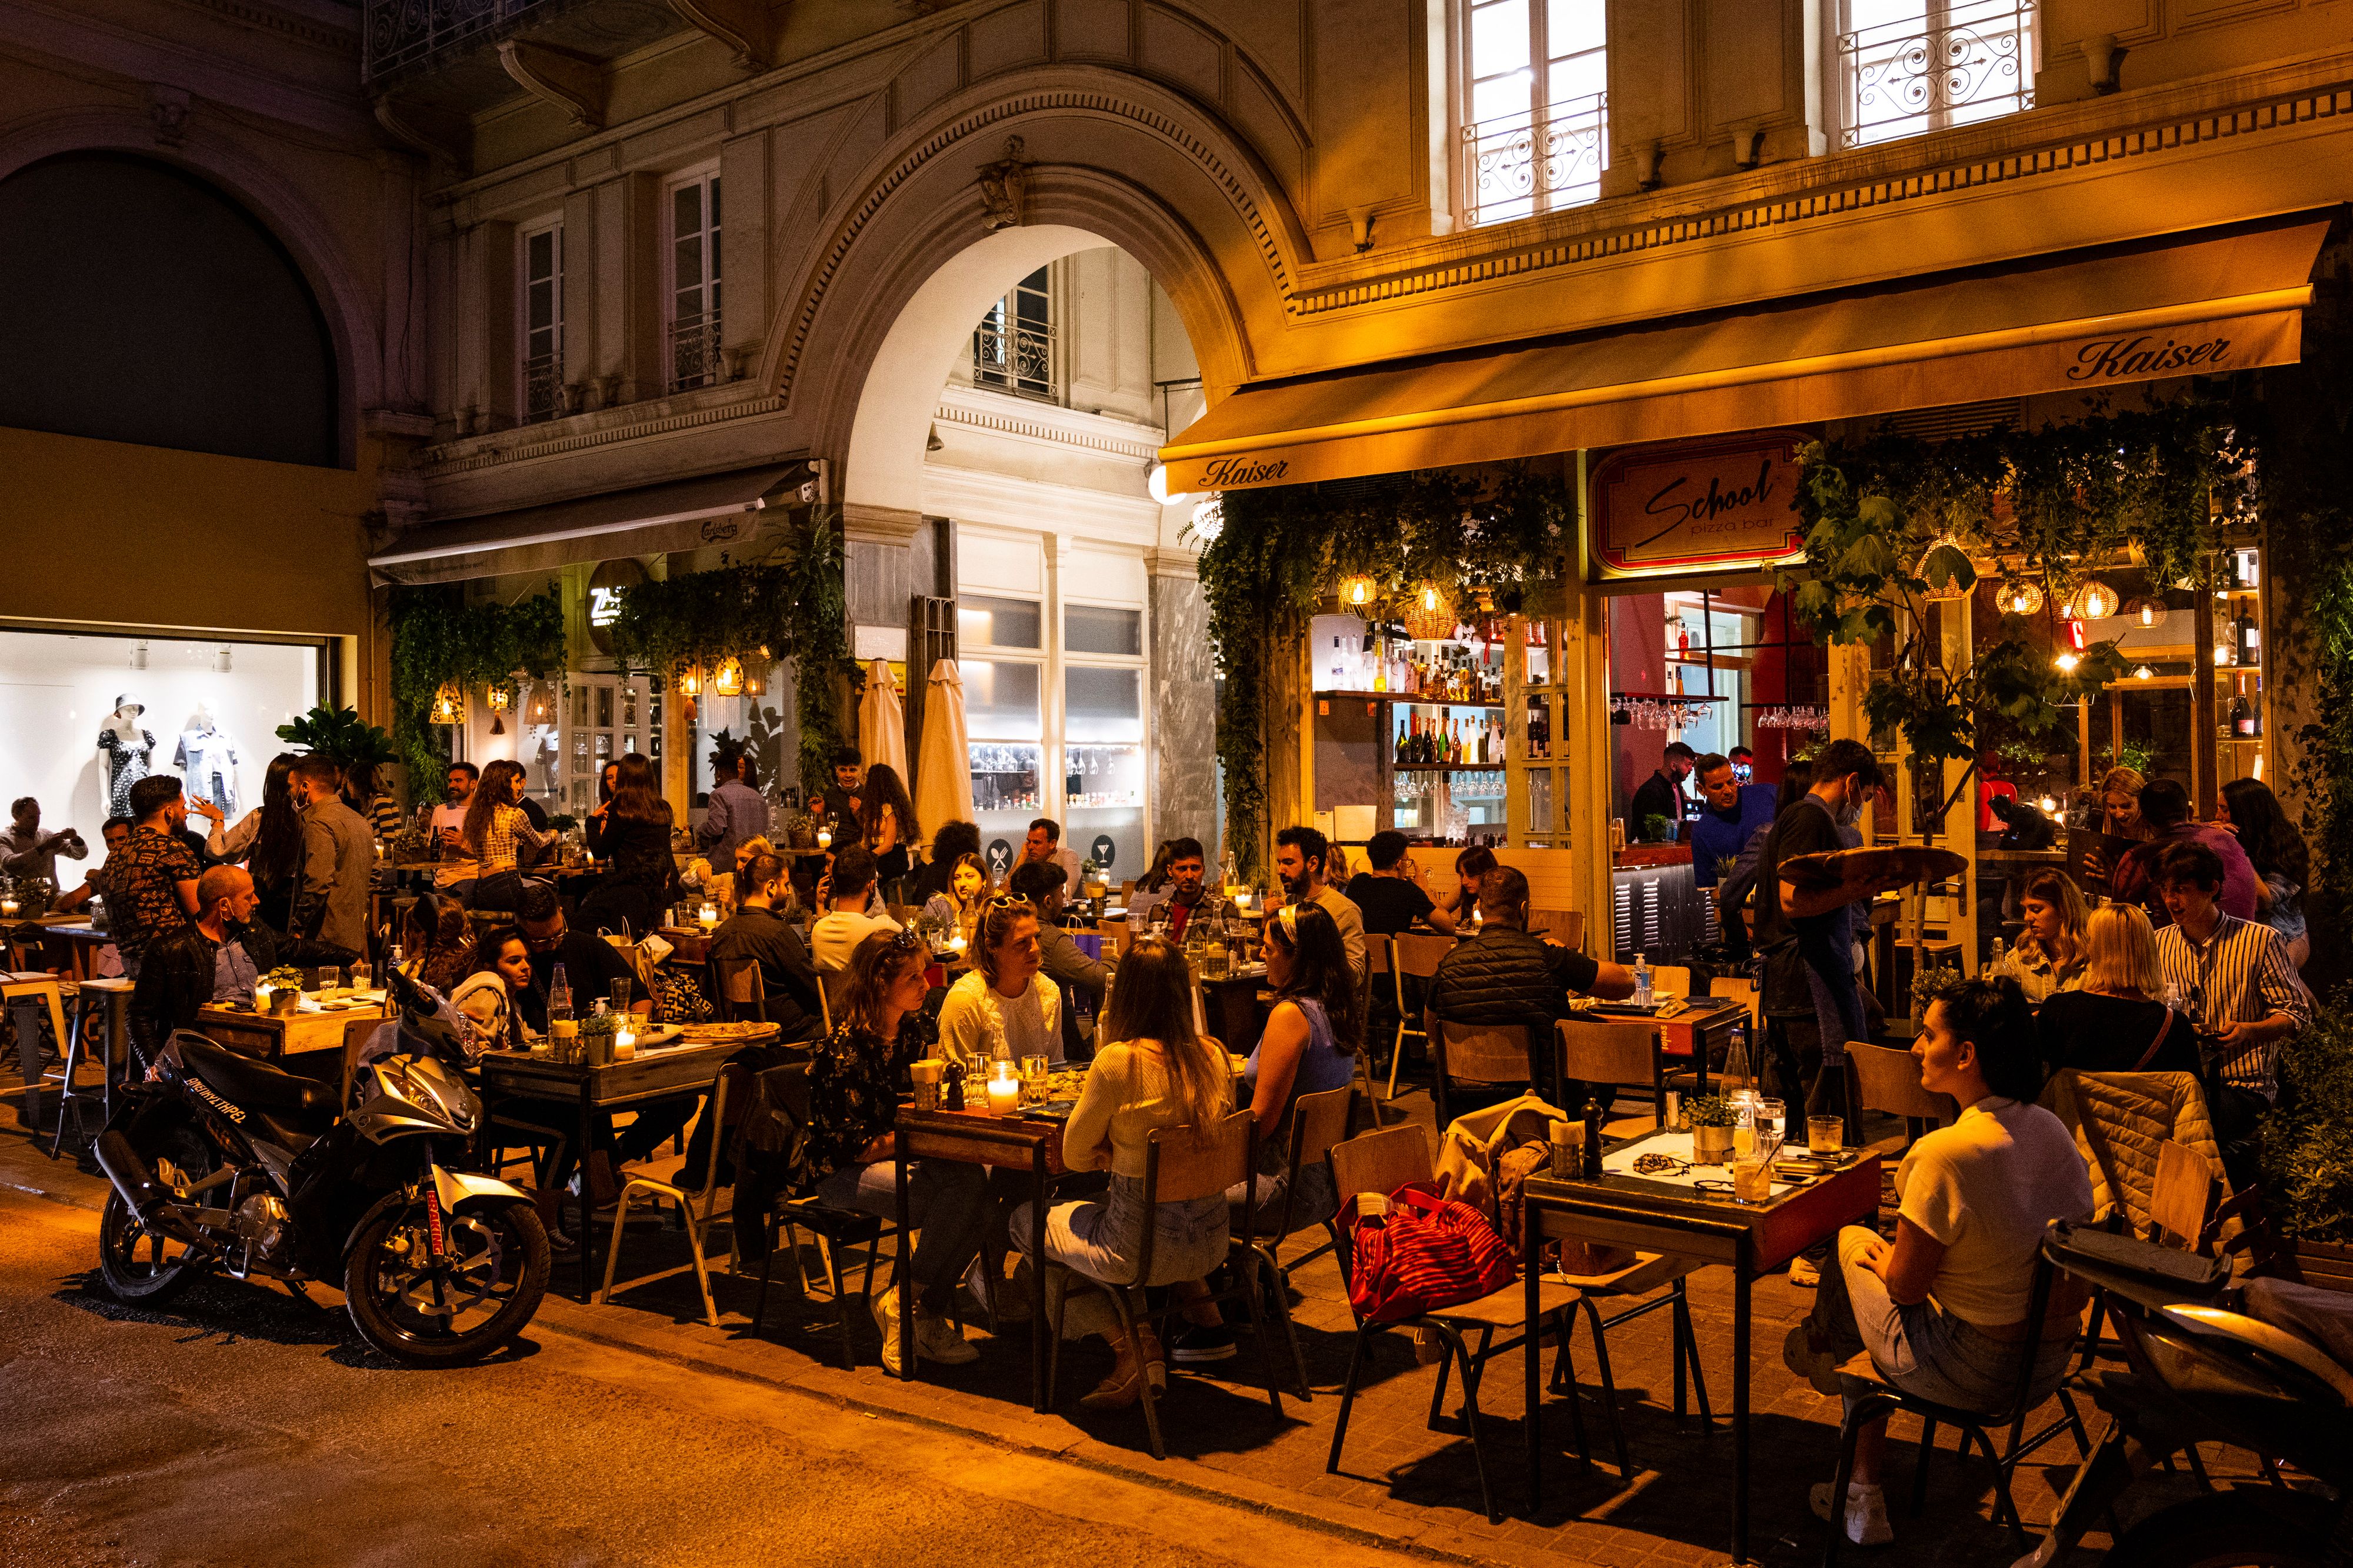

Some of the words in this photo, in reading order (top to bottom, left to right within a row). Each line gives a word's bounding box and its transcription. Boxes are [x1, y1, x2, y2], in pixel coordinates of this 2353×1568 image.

[2066, 336, 2231, 381] Kaiser
[1198, 457, 1289, 487] Kaiser
[1635, 459, 1774, 548] School
[701, 518, 738, 543] Carlsberg
[1691, 521, 1737, 536] pizza
[1743, 518, 1774, 529] bar
[427, 1190, 444, 1255] BRAKING
